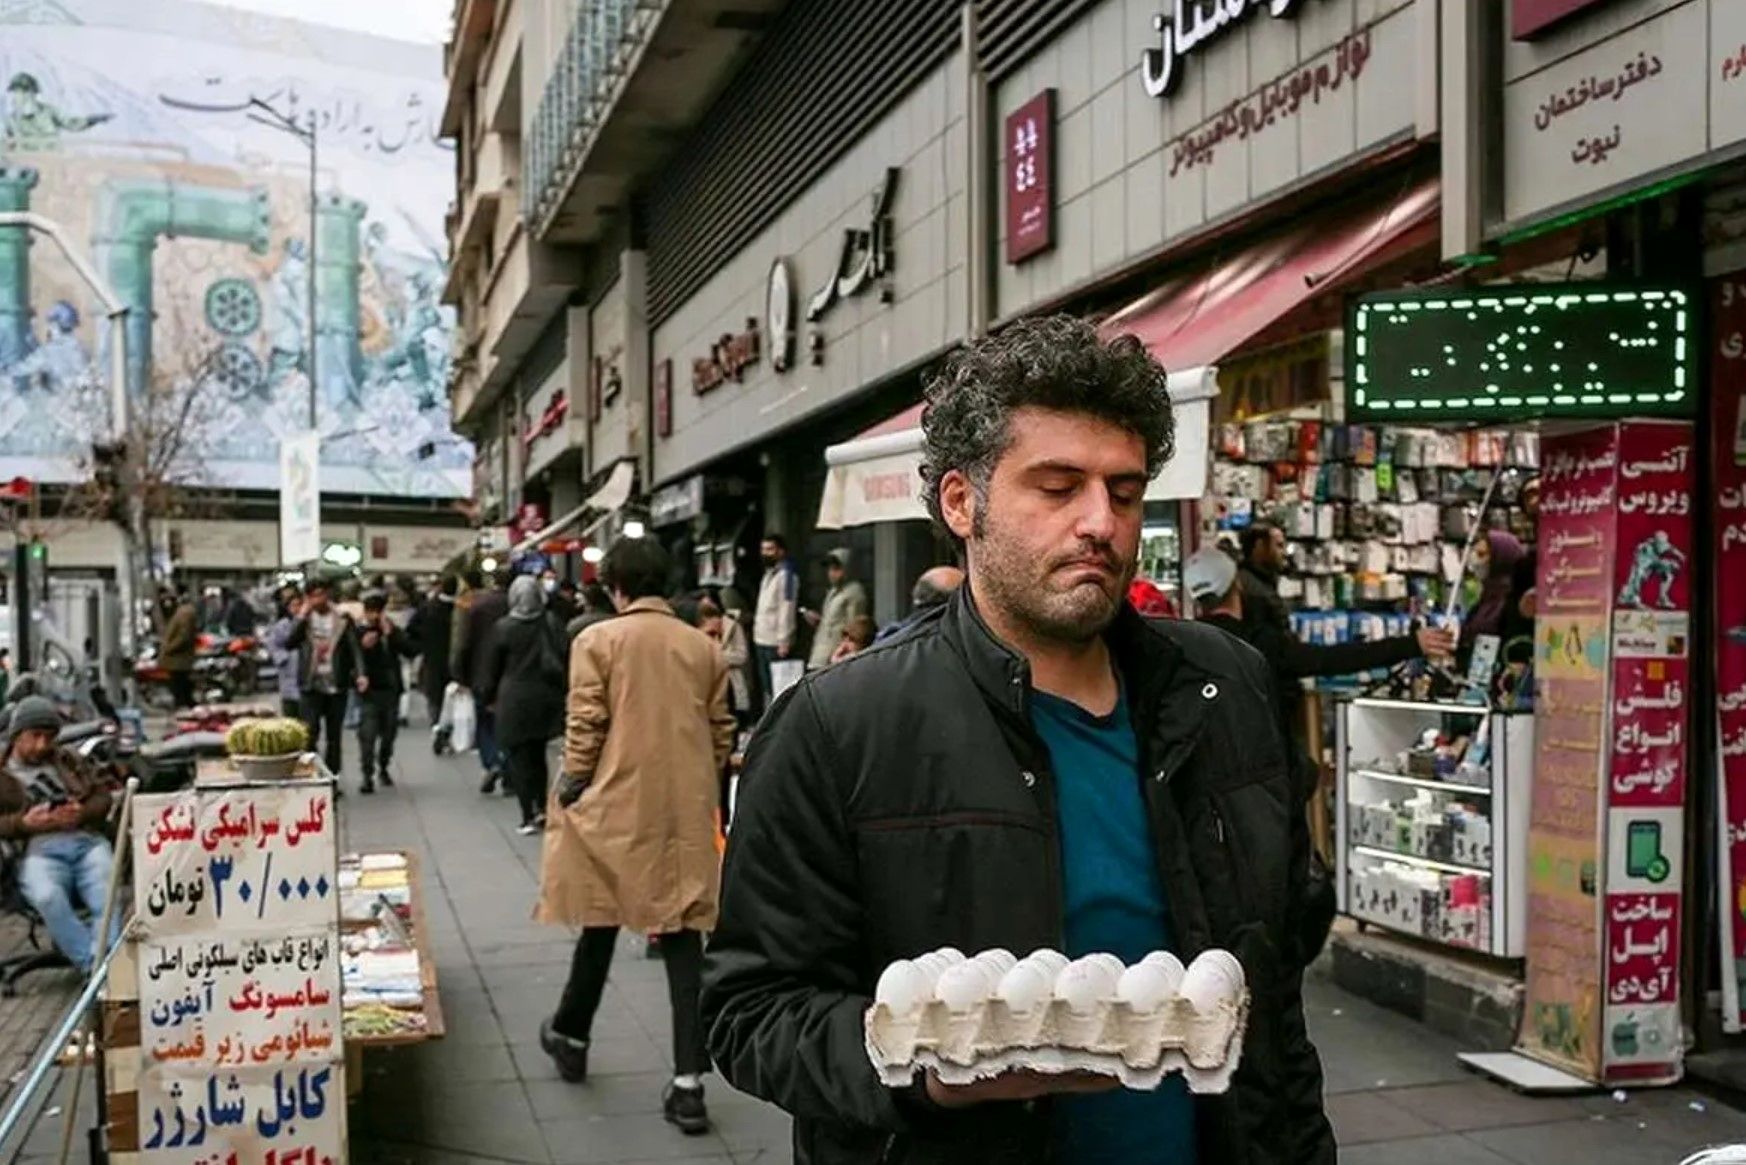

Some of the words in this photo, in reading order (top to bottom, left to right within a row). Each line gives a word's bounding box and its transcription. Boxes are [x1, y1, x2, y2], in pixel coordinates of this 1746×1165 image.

[1314, 30, 1371, 105] لوازم
[1253, 70, 1312, 133] موبایل
[1169, 99, 1240, 177] کامپیوتر
[1621, 445, 1690, 478] آنتی
[1619, 489, 1690, 516] ویروس
[1616, 680, 1682, 715] فلش
[1616, 722, 1681, 754] انواع
[1613, 759, 1679, 793] گوشی
[147, 804, 196, 854] نشکن
[202, 801, 280, 851] سرامیکی
[286, 796, 328, 846] گلس
[148, 865, 204, 916] تومان
[1612, 896, 1672, 921] ساخت
[149, 946, 183, 980] اصلی
[242, 941, 267, 973] های
[271, 936, 294, 971] قاب
[298, 938, 329, 971] انواع
[1613, 926, 1668, 965] اپل
[150, 980, 215, 1026] آیفون
[229, 978, 330, 1019] سامسونگ
[152, 1026, 205, 1061] قیمت
[216, 1031, 244, 1064] زیر
[252, 1017, 332, 1061] شیائومی
[144, 1073, 245, 1149] شارژر
[257, 1067, 331, 1138] کابل
